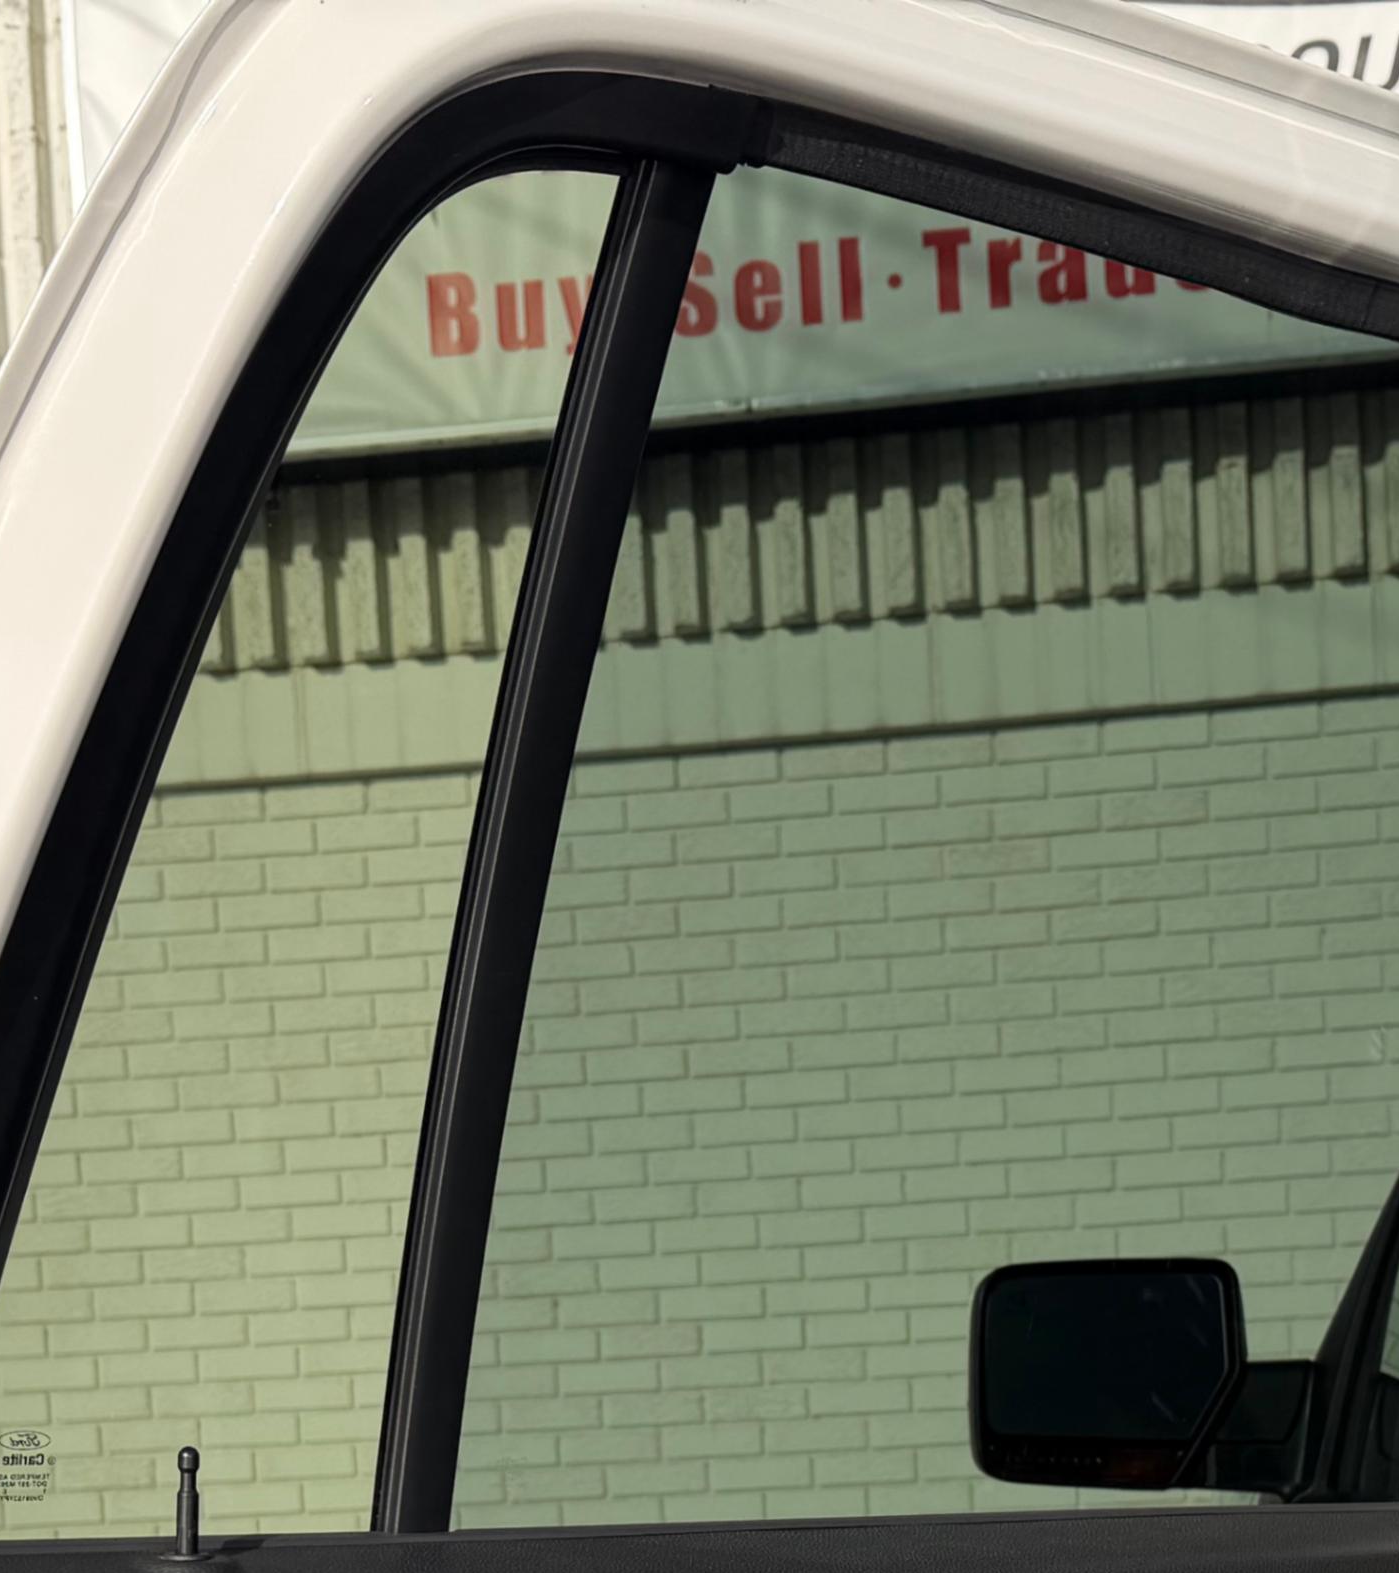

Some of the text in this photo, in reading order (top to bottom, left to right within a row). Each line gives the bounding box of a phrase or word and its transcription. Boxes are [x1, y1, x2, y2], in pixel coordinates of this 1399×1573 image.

[427, 271, 593, 357] Buy
[676, 236, 863, 338] Sell
[923, 228, 1209, 315] Trad
